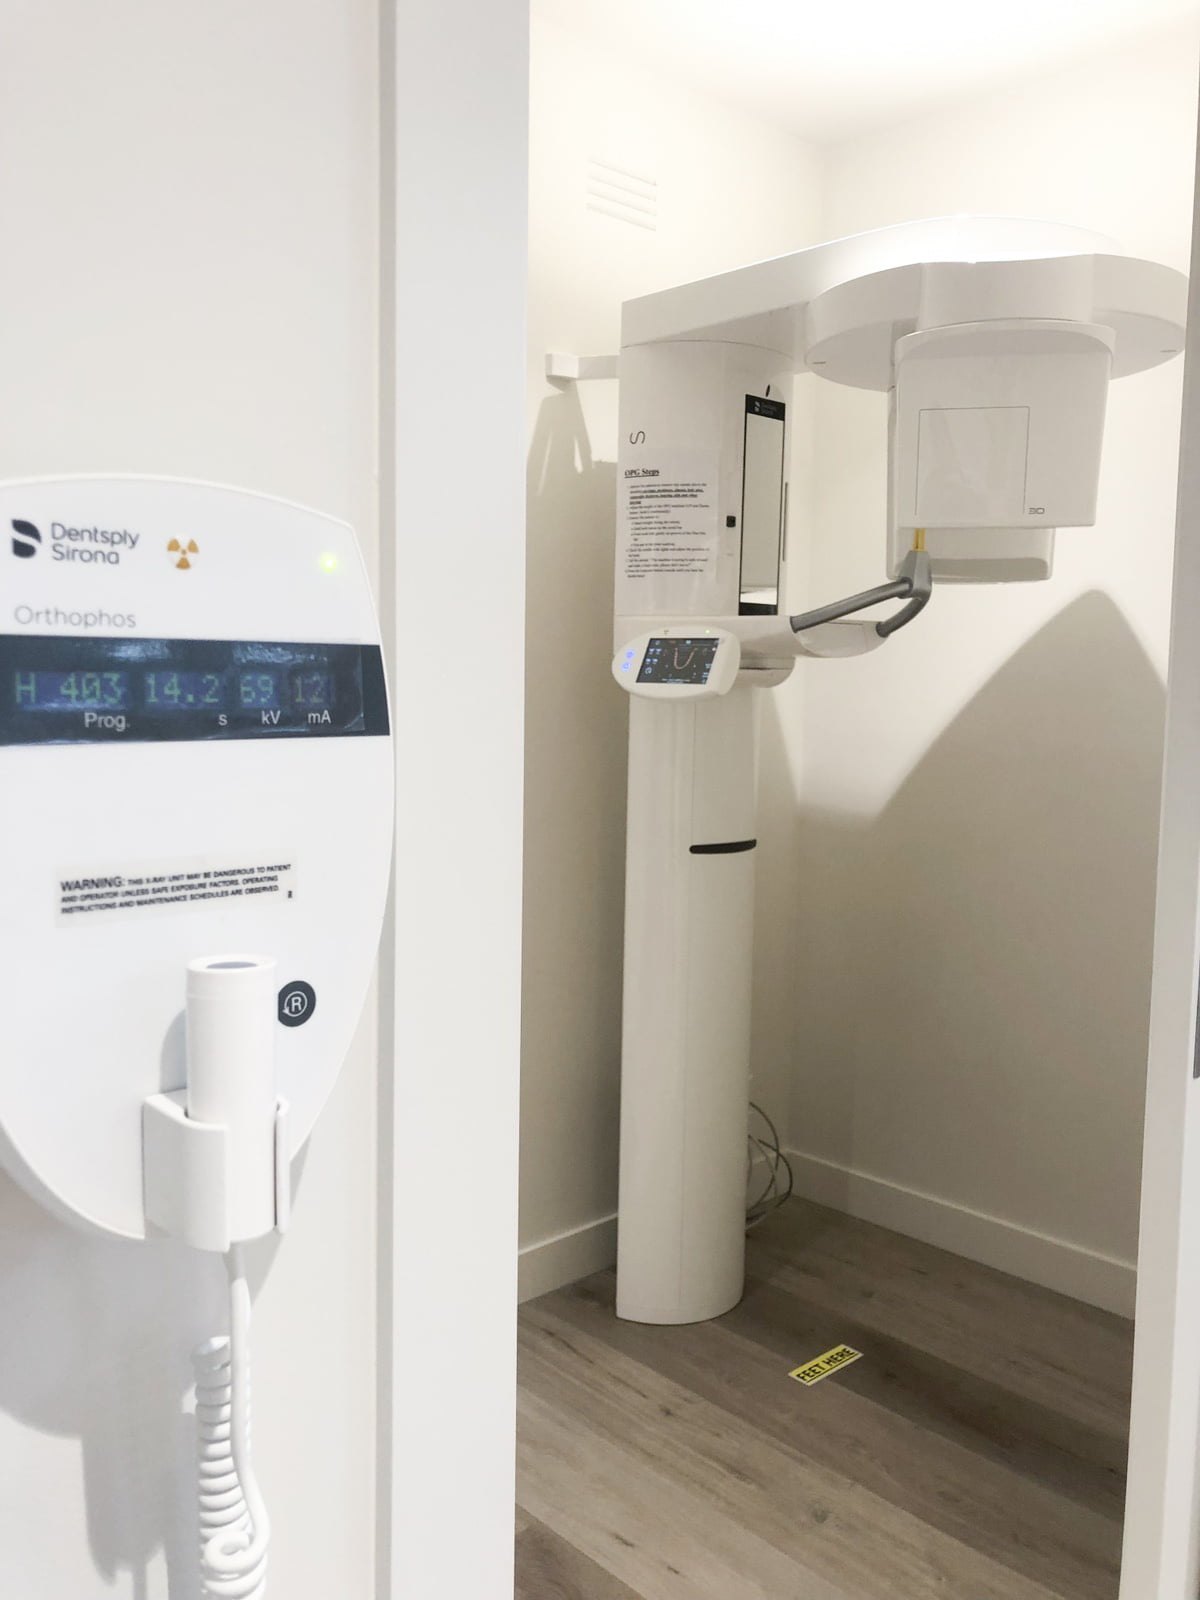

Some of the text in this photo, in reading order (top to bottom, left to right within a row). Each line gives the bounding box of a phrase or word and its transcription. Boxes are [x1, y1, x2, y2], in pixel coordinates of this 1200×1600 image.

[51, 523, 139, 550] Dentsply
[52, 544, 120, 565] Sirona
[14, 606, 137, 629] Orthophos
[15, 672, 324, 705] H 403 14.2 69 12
[218, 715, 228, 726] s
[261, 711, 281, 725] kV
[308, 710, 331, 724] mA
[213, 868, 255, 878] DANGEROUS
[267, 864, 291, 872] PATIENT
[190, 890, 229, 901] SCHEDULES
[796, 1348, 855, 1381] FEET HERE
